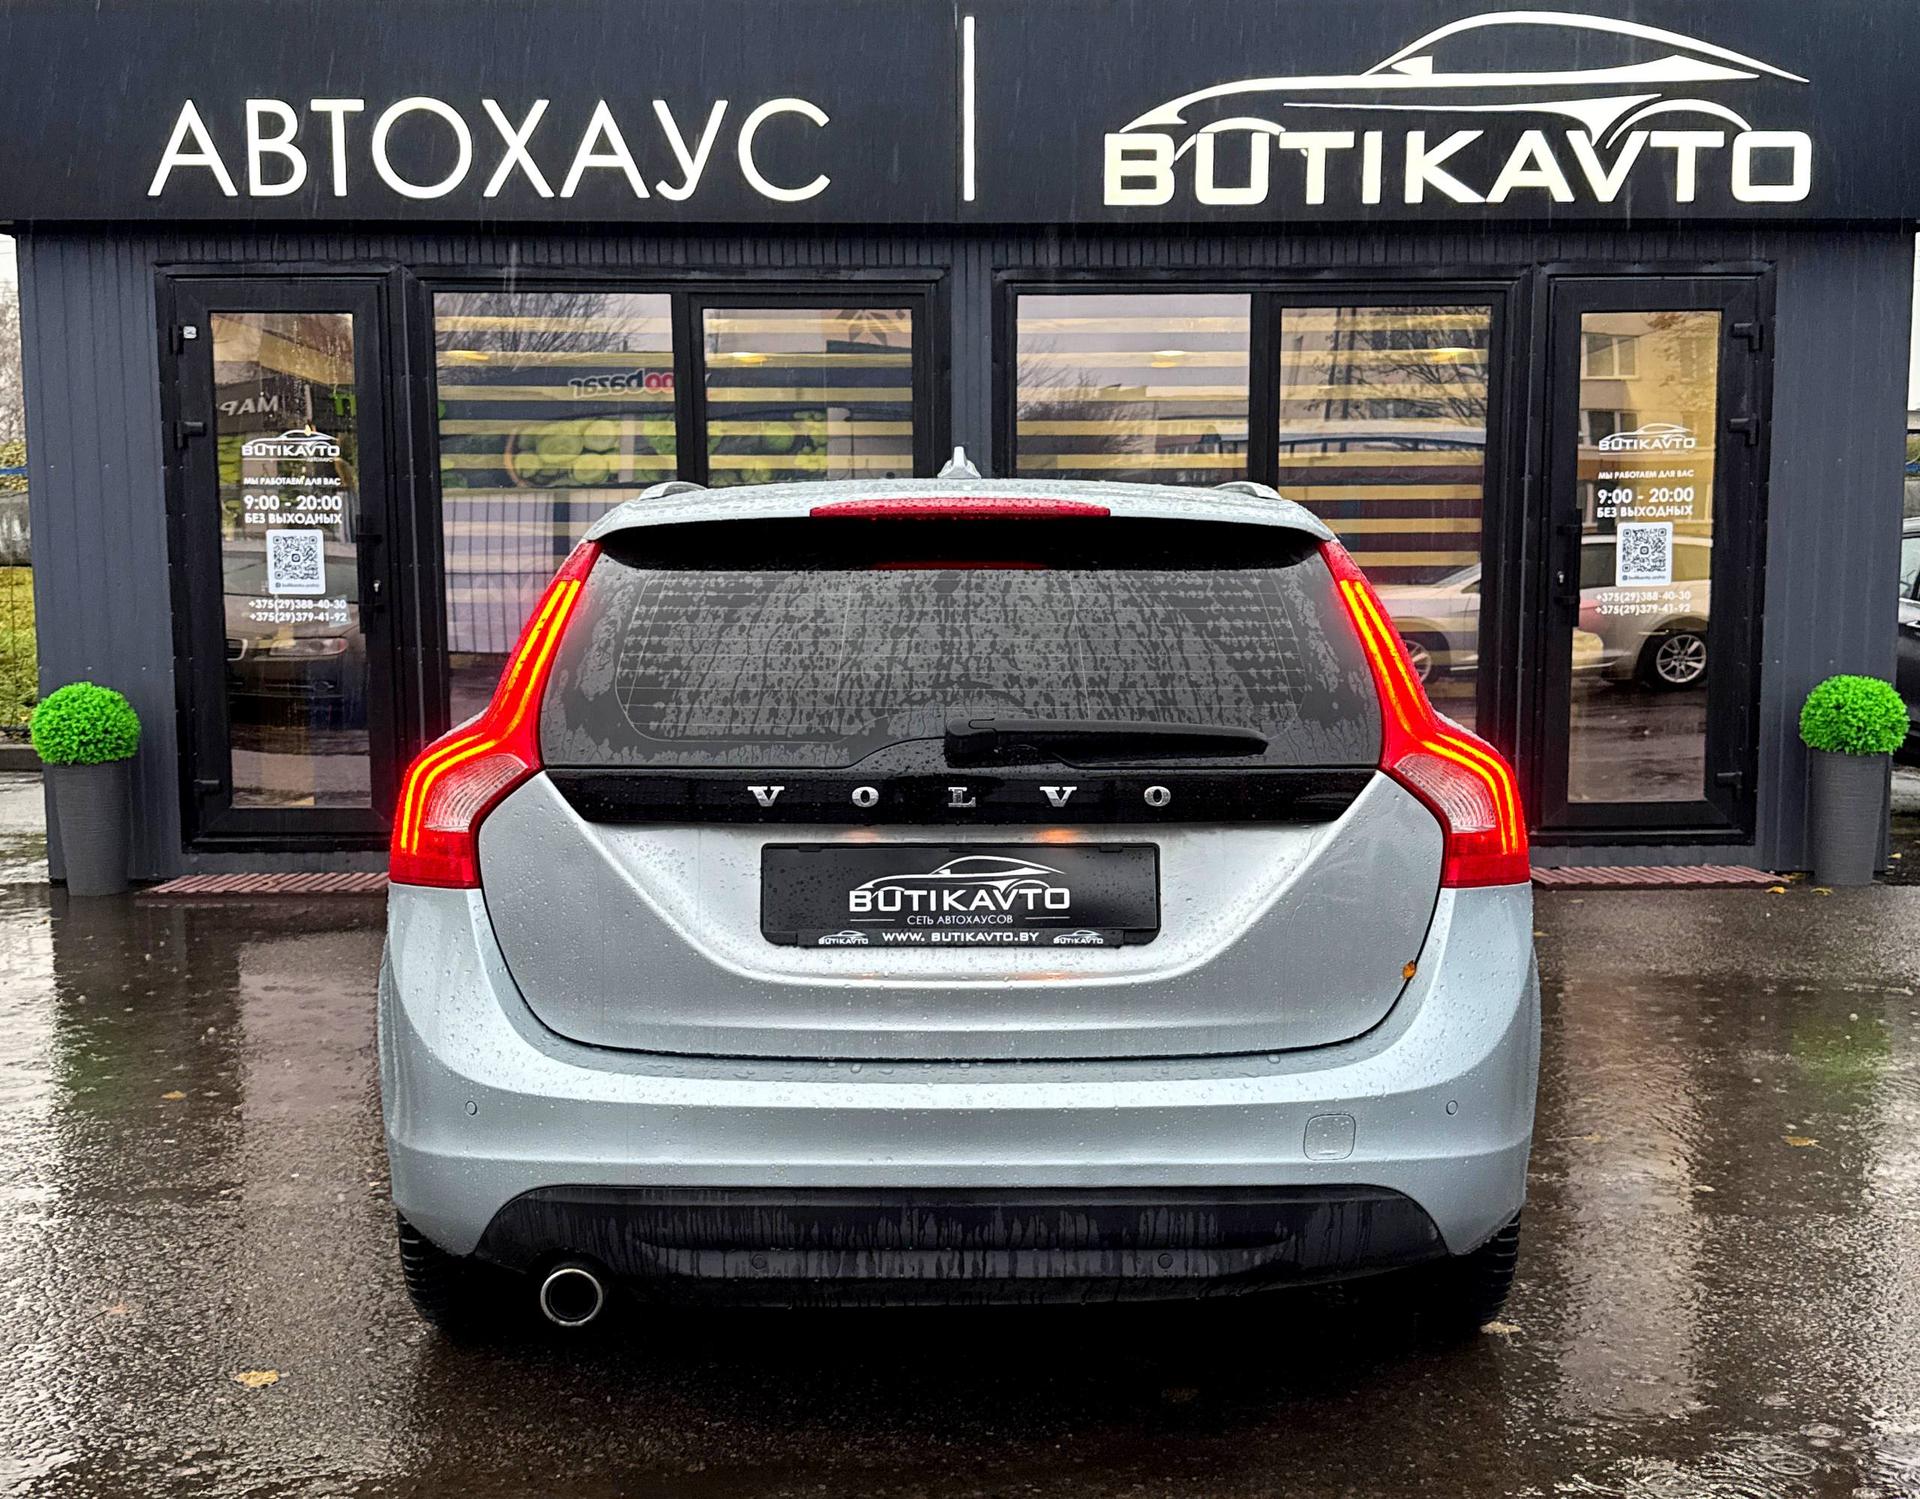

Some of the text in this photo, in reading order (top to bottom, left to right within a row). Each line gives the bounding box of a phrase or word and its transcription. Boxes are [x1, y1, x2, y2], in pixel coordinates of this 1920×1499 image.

[148, 96, 831, 201] АВТОХАУС
[1103, 130, 1813, 206] BUTIKAVTO
[241, 444, 341, 457] BUTIKAVTO
[1598, 437, 1696, 451] BUTIKAVTO
[1598, 469, 1694, 480] МЫ РАБОТАЕМ ДЛЯ ВАС
[243, 477, 341, 486] МЫ РАБОТАЕМ ДЛЯ ВАС
[1597, 488, 1633, 504] 9:00
[1648, 487, 1694, 503] 20:00
[244, 495, 280, 510] 9:00
[296, 495, 342, 510] 20:00
[1597, 505, 1693, 518] БЕЗ ВЫХОДНЫХ
[244, 513, 342, 525] БЕЗ ВЫХОДНЫХ
[249, 611, 347, 623] +375(29)379-41-92
[747, 785, 1172, 808] VOLVO
[848, 887, 1071, 913] BUTIKAVTO
[906, 914, 1014, 925] СЕТЬ АВТОХАУСОВ
[818, 937, 869, 945] BUTIKAVTO
[882, 931, 1040, 943] WWW. BUTIKAVTO.BY
[1053, 937, 1104, 945] BUTIKAVTO
